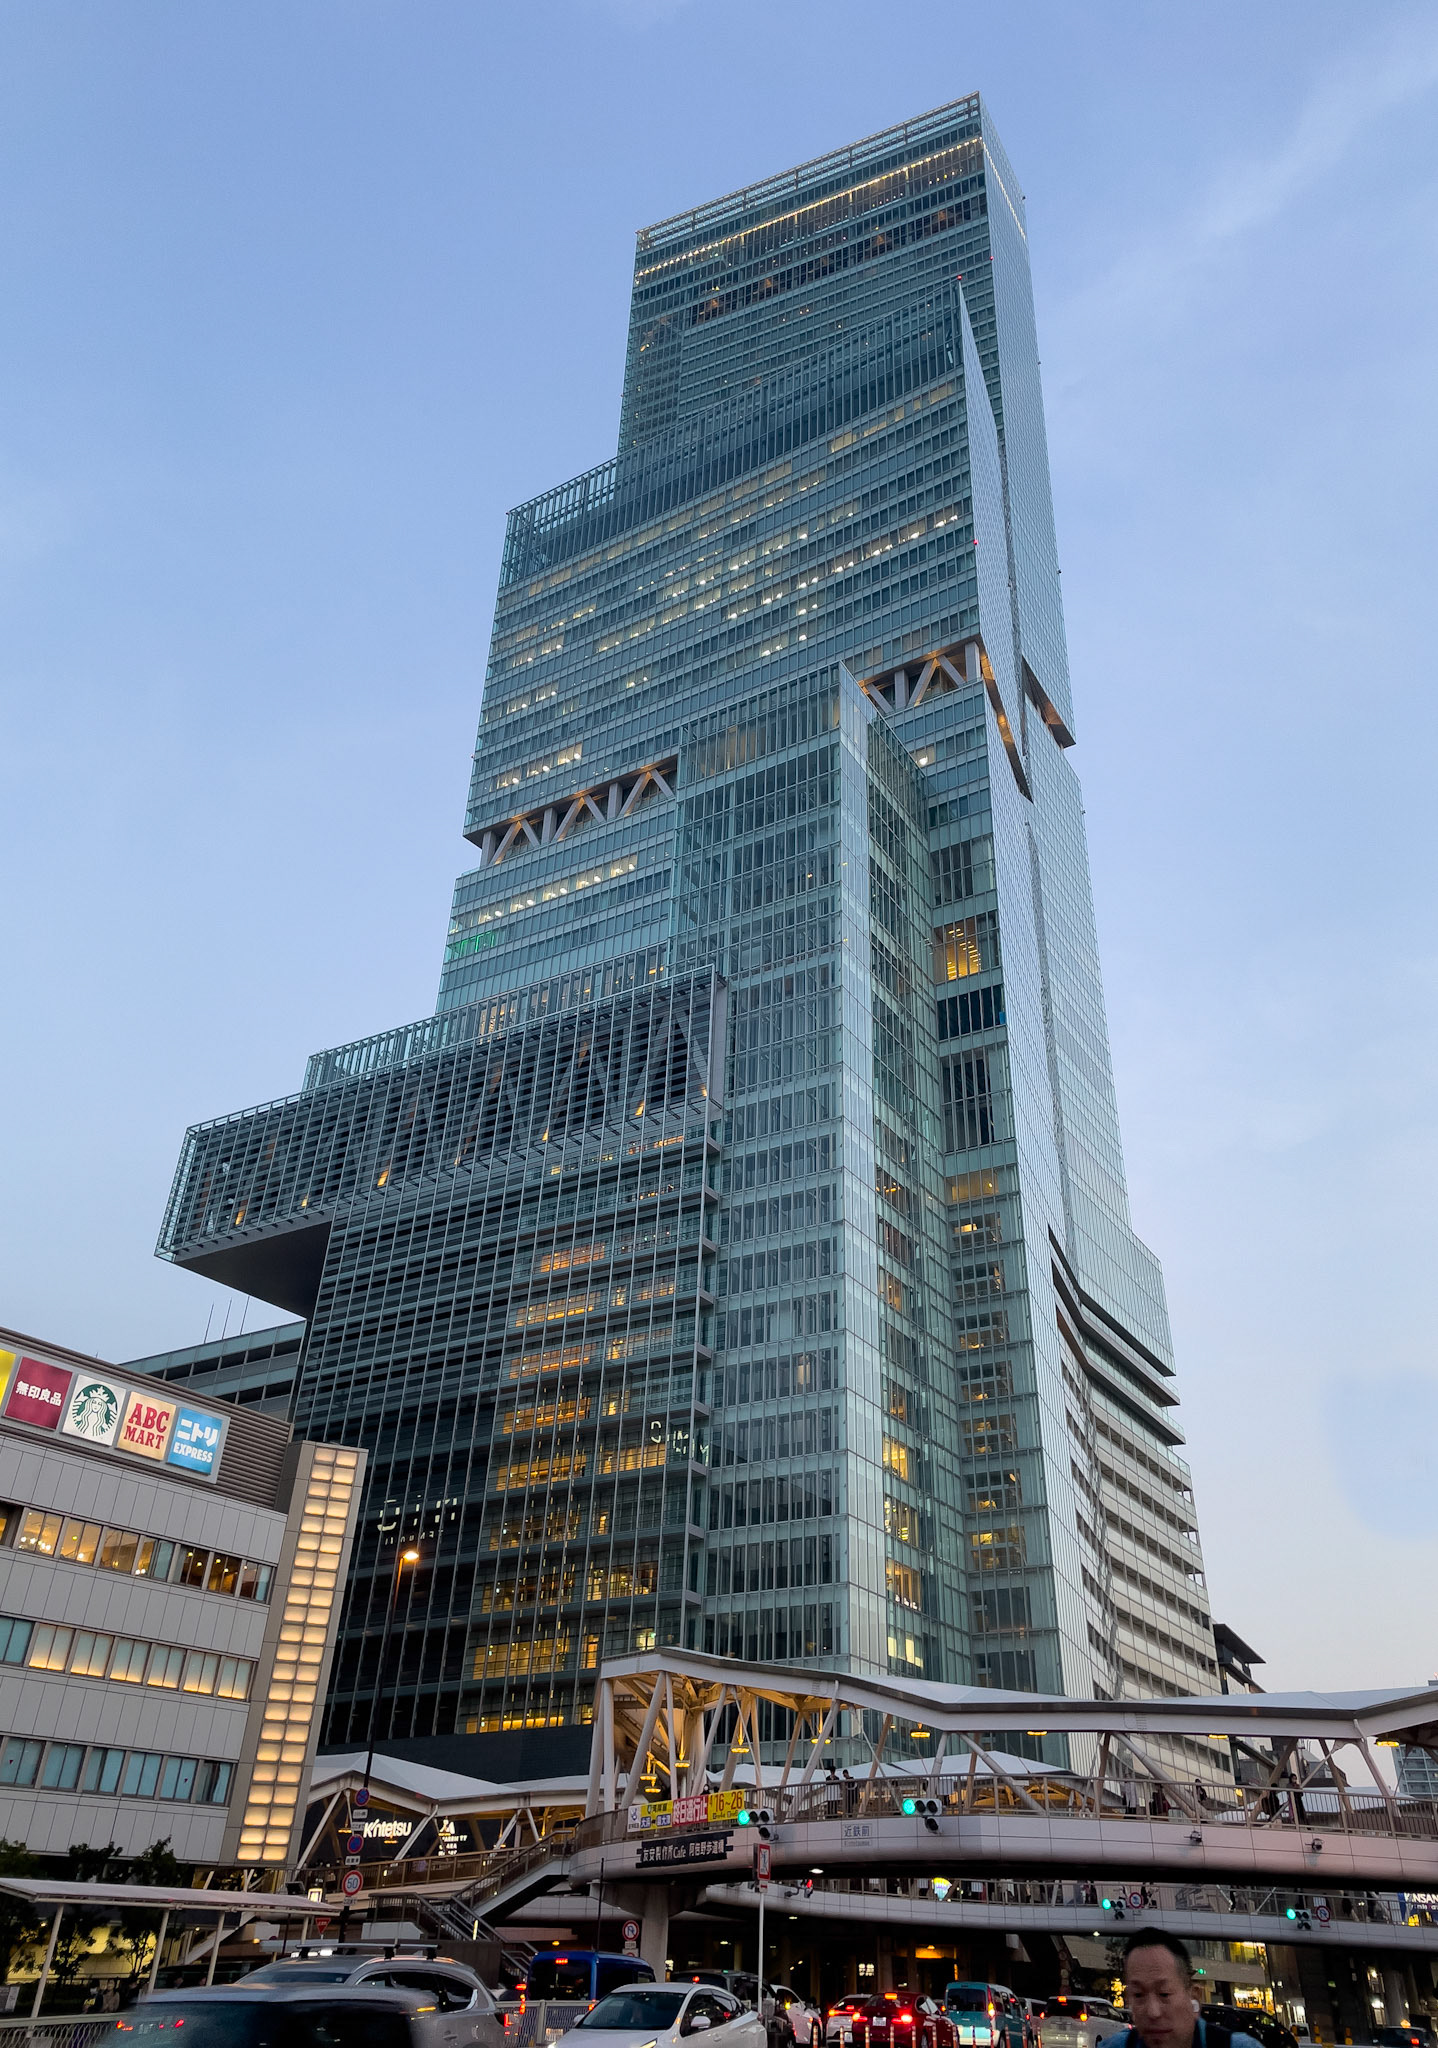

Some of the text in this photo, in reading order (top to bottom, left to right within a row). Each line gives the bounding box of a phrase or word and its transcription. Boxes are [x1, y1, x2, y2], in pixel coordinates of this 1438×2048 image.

[15, 1381, 62, 1406] 無印良品
[128, 1403, 170, 1433] ABC
[124, 1425, 165, 1450] MART
[176, 1419, 219, 1446] ニトリ
[173, 1442, 213, 1463] EXPRESS
[844, 1825, 870, 1837] 近鉄前
[346, 1878, 359, 1889] 50
